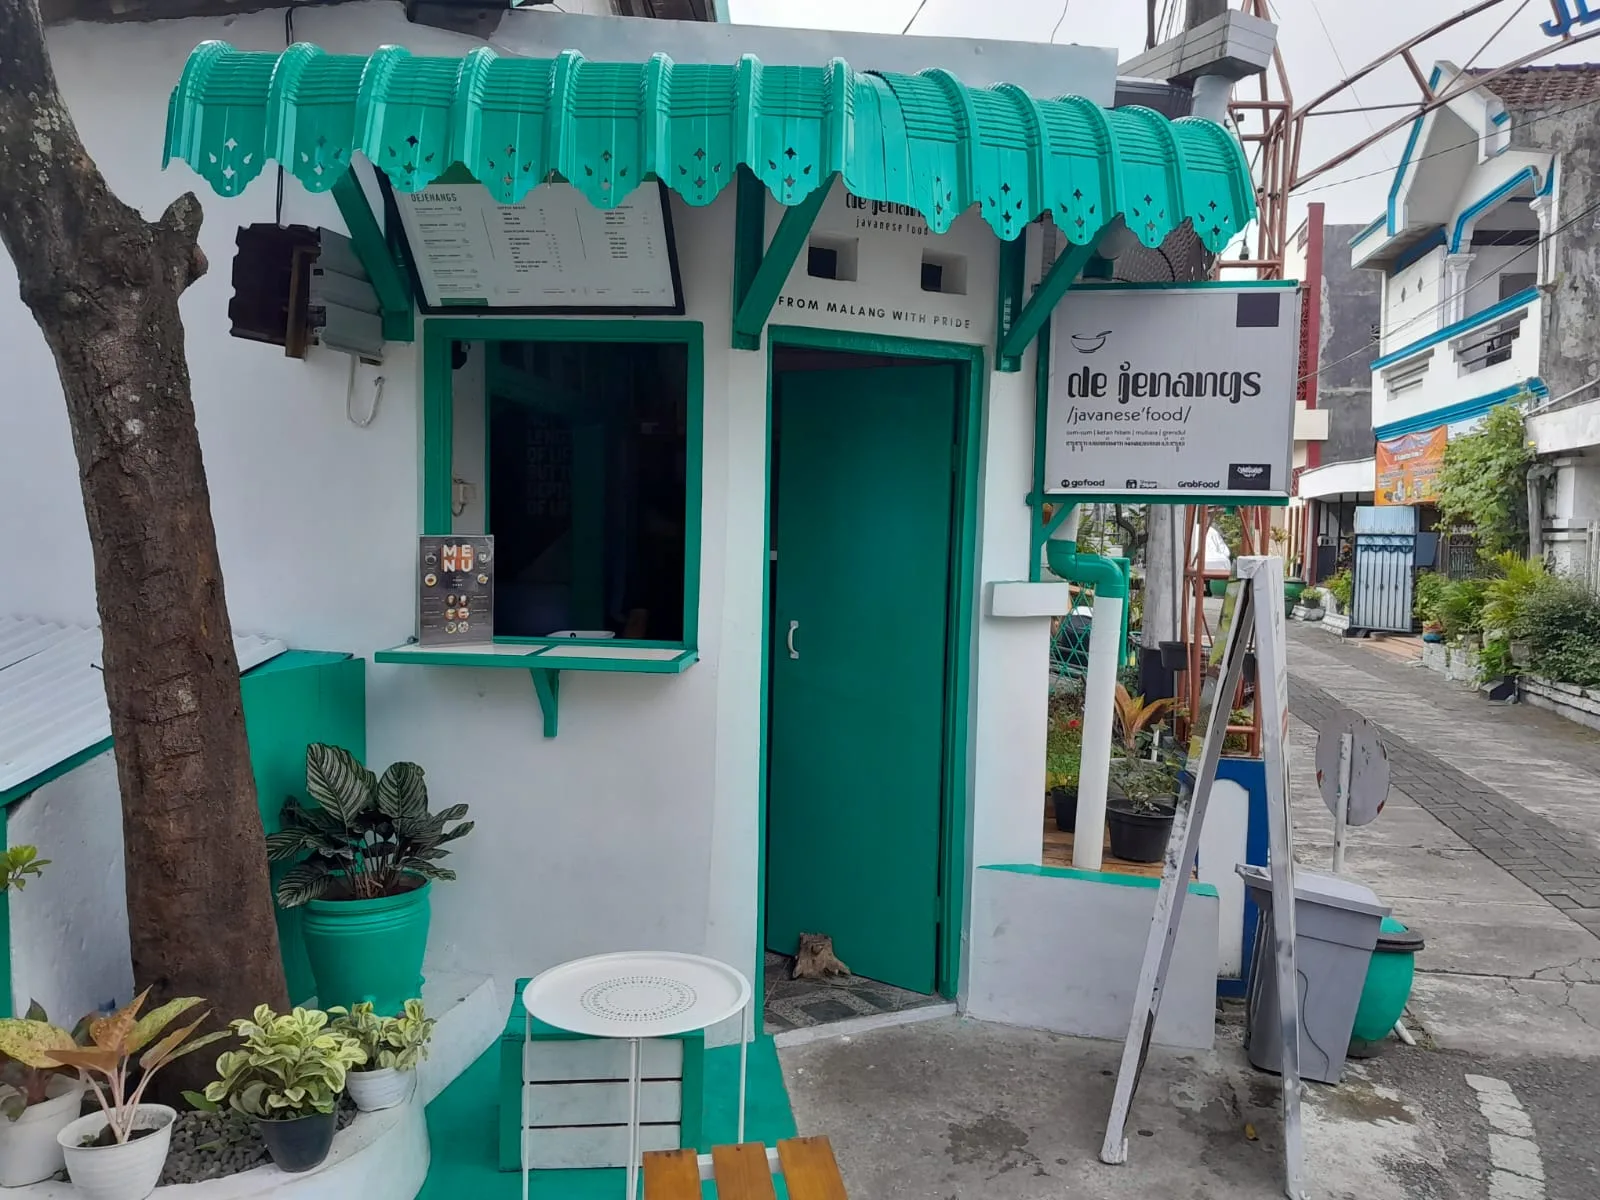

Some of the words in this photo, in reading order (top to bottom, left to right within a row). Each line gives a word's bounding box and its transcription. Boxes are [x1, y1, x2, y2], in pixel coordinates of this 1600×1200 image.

[871, 199, 926, 217] jenan
[855, 216, 902, 233] javanese
[906, 224, 929, 236] food
[778, 296, 819, 311] FROM
[826, 302, 886, 319] MALANG
[892, 310, 927, 324] WITH
[933, 315, 971, 329] PRIDE
[1067, 366, 1108, 398] de
[1118, 361, 1262, 404] jenangs
[1071, 479, 1105, 488] gofood
[1177, 480, 1220, 488] GrabFood
